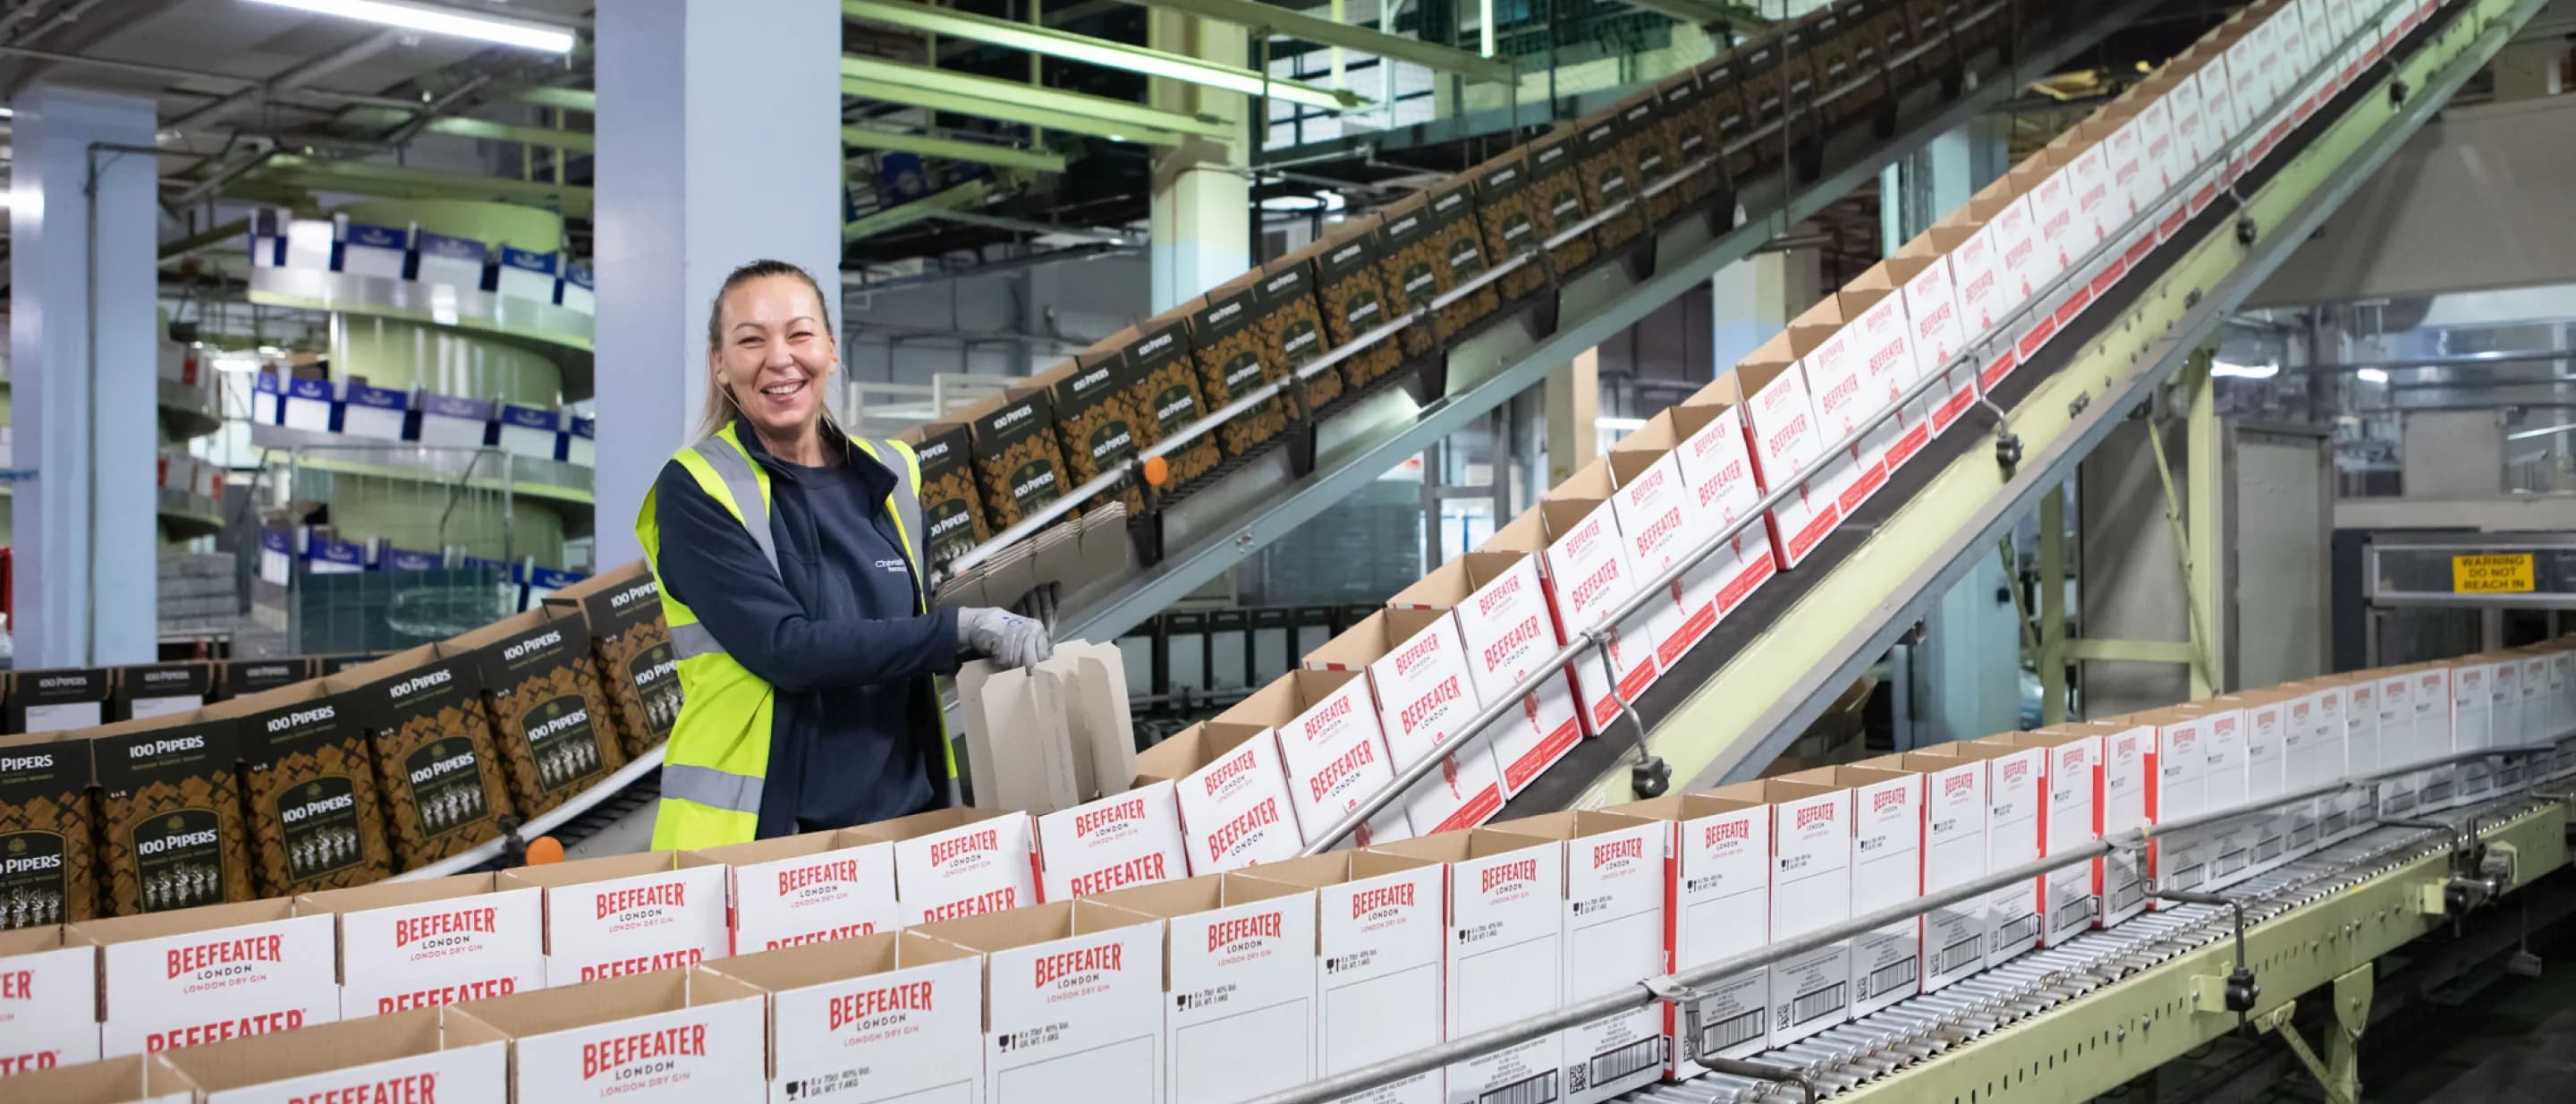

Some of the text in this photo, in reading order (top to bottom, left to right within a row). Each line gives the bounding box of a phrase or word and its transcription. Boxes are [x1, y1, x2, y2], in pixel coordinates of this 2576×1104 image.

[1631, 470, 1664, 506] BEEFEATER
[1699, 459, 1743, 508] BEEFEATER
[1566, 520, 1600, 559] BEEFEATER
[1637, 506, 1682, 558] BEEFEATER
[2462, 556, 2524, 566] WARNING
[2469, 567, 2517, 577] DO NOT
[611, 582, 658, 608] 100 PIPER
[1479, 575, 1521, 616] BEEFEATER
[1572, 558, 1620, 614] BEEFEATER
[2464, 579, 2525, 589] REACH IN
[504, 631, 561, 660] 100 PIPERS
[1395, 633, 1440, 676] BEEFEATER
[1484, 616, 1541, 673] BEEFEATER
[1504, 645, 1530, 667] LONDON
[390, 669, 451, 699] 100 PIPERS
[635, 660, 676, 685] 100 PIPE
[1304, 695, 1352, 742] BEEFEATER
[1401, 675, 1461, 735] BEEFEATER
[1421, 706, 1449, 730] LONDON
[267, 706, 335, 733] 100 PIPERS
[528, 709, 588, 742] 100 PIPERS
[130, 735, 205, 759] 100 PIPERS
[1, 754, 53, 772] PIPERS
[411, 752, 474, 785] 100 PIPERS
[1204, 750, 1257, 797] BEEFEATER
[1309, 739, 1374, 803] BEEFEATER
[1221, 776, 1246, 794] LONDON
[1331, 772, 1361, 797] LONDON
[283, 793, 353, 823] 100 PIPERS
[1874, 787, 1905, 812] BEEFEATER
[1076, 799, 1145, 837] BEEFEATER
[1096, 822, 1129, 837] LONDON
[1208, 797, 1279, 863] BEEFEATER
[1797, 803, 1835, 830] BEEFEATER
[140, 828, 217, 855] 100 PIPERS
[1231, 832, 1265, 857] LONDON
[1706, 820, 1749, 849] BEEFEATER
[931, 830, 998, 867] BEEFEATER
[950, 853, 982, 868] LONDON
[1594, 837, 1641, 870] BEEFEATER
[5, 853, 62, 873] PIPERS
[1071, 853, 1165, 899] BEEFEATER
[1606, 859, 1629, 870] LONDON
[779, 860, 858, 896] BEEFEATER
[1482, 859, 1536, 895] BEEFEATER
[1496, 883, 1522, 895] LONDON
[597, 883, 684, 920] BEEFEATER
[801, 886, 837, 897] LONDON
[1352, 882, 1414, 920] BEEFEATER
[396, 908, 496, 948] BEEFEATER
[620, 908, 662, 921] LONDON
[1368, 909, 1398, 921] LONDON
[422, 936, 470, 949] LONDON
[1208, 912, 1281, 953] BEEFEATER
[167, 935, 282, 980] BEEFEATER
[411, 950, 446, 961] LONDON
[450, 947, 466, 955] DRY
[1227, 940, 1262, 954] LONDON
[198, 964, 252, 981] LONDON
[1036, 944, 1122, 989] BEEFEATER
[184, 974, 267, 994] LONDON DRY GIN
[1047, 984, 1110, 1003] LONDON DRY GIN
[1057, 973, 1099, 989] LONDON
[830, 981, 932, 1031] BEEFEATER
[844, 1025, 919, 1047] LONDON DRY GIN
[857, 1014, 906, 1031] LONDON
[583, 1023, 706, 1081] BEEFEATER
[615, 1060, 674, 1081] LONDON
[601, 1074, 690, 1097] LONDON DRY GIN
